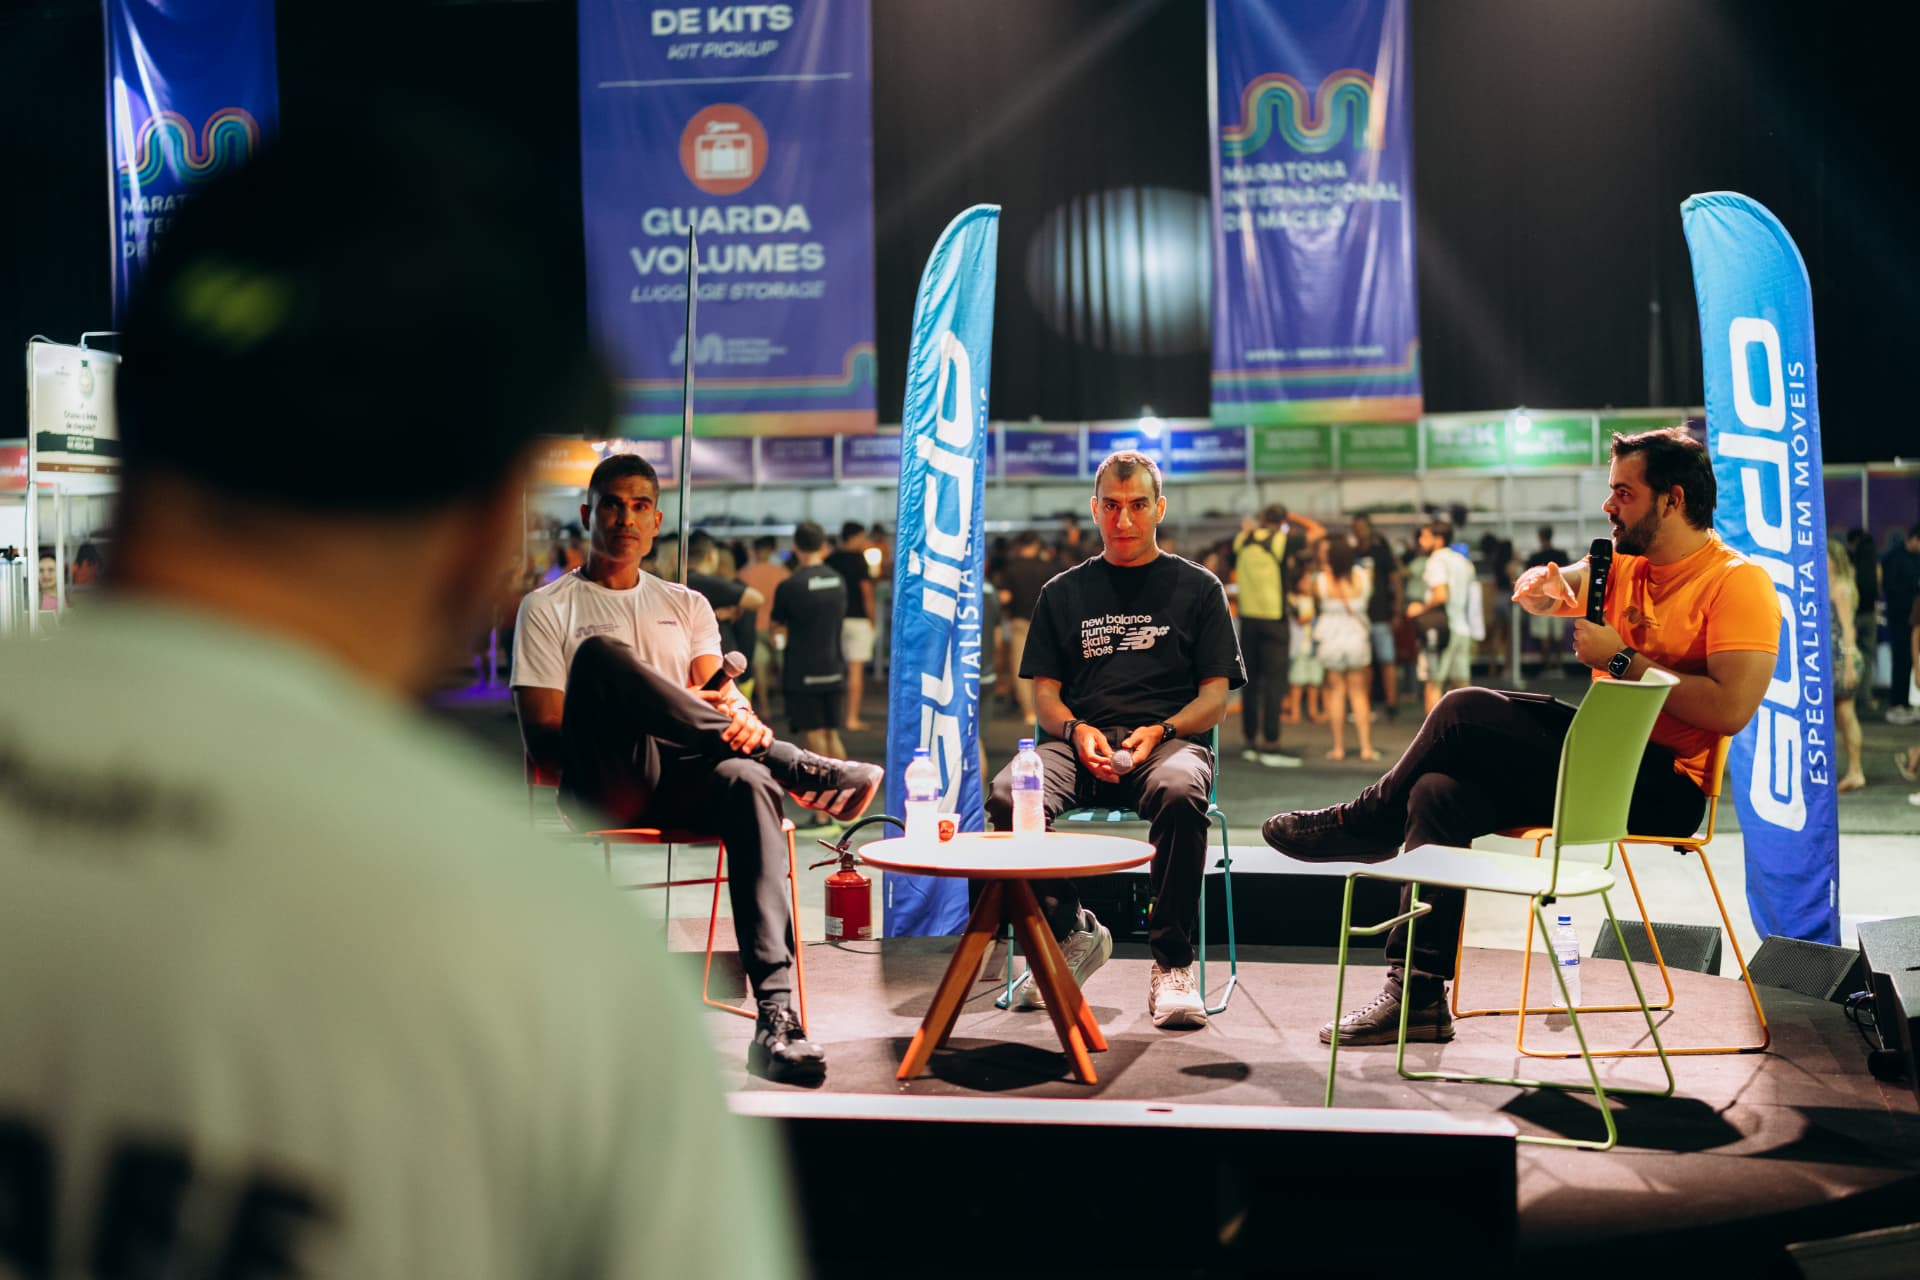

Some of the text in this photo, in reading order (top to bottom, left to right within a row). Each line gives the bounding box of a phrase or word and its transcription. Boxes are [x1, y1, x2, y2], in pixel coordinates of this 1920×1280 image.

[652, 4, 794, 36] DE KITS
[667, 40, 779, 60] KIT PICKUP
[1223, 160, 1348, 183] MARATONA
[641, 204, 812, 236] GUARDA
[630, 242, 826, 276] VOLUMES
[630, 280, 827, 303] LUGGGE STORAGE
[1788, 361, 1829, 786] ESPECIALISTA EM MÓVEIS
[1081, 614, 1152, 629] new balance
[1081, 623, 1126, 638] numeric
[1082, 635, 1111, 648] skate
[1083, 645, 1114, 659] shoes
